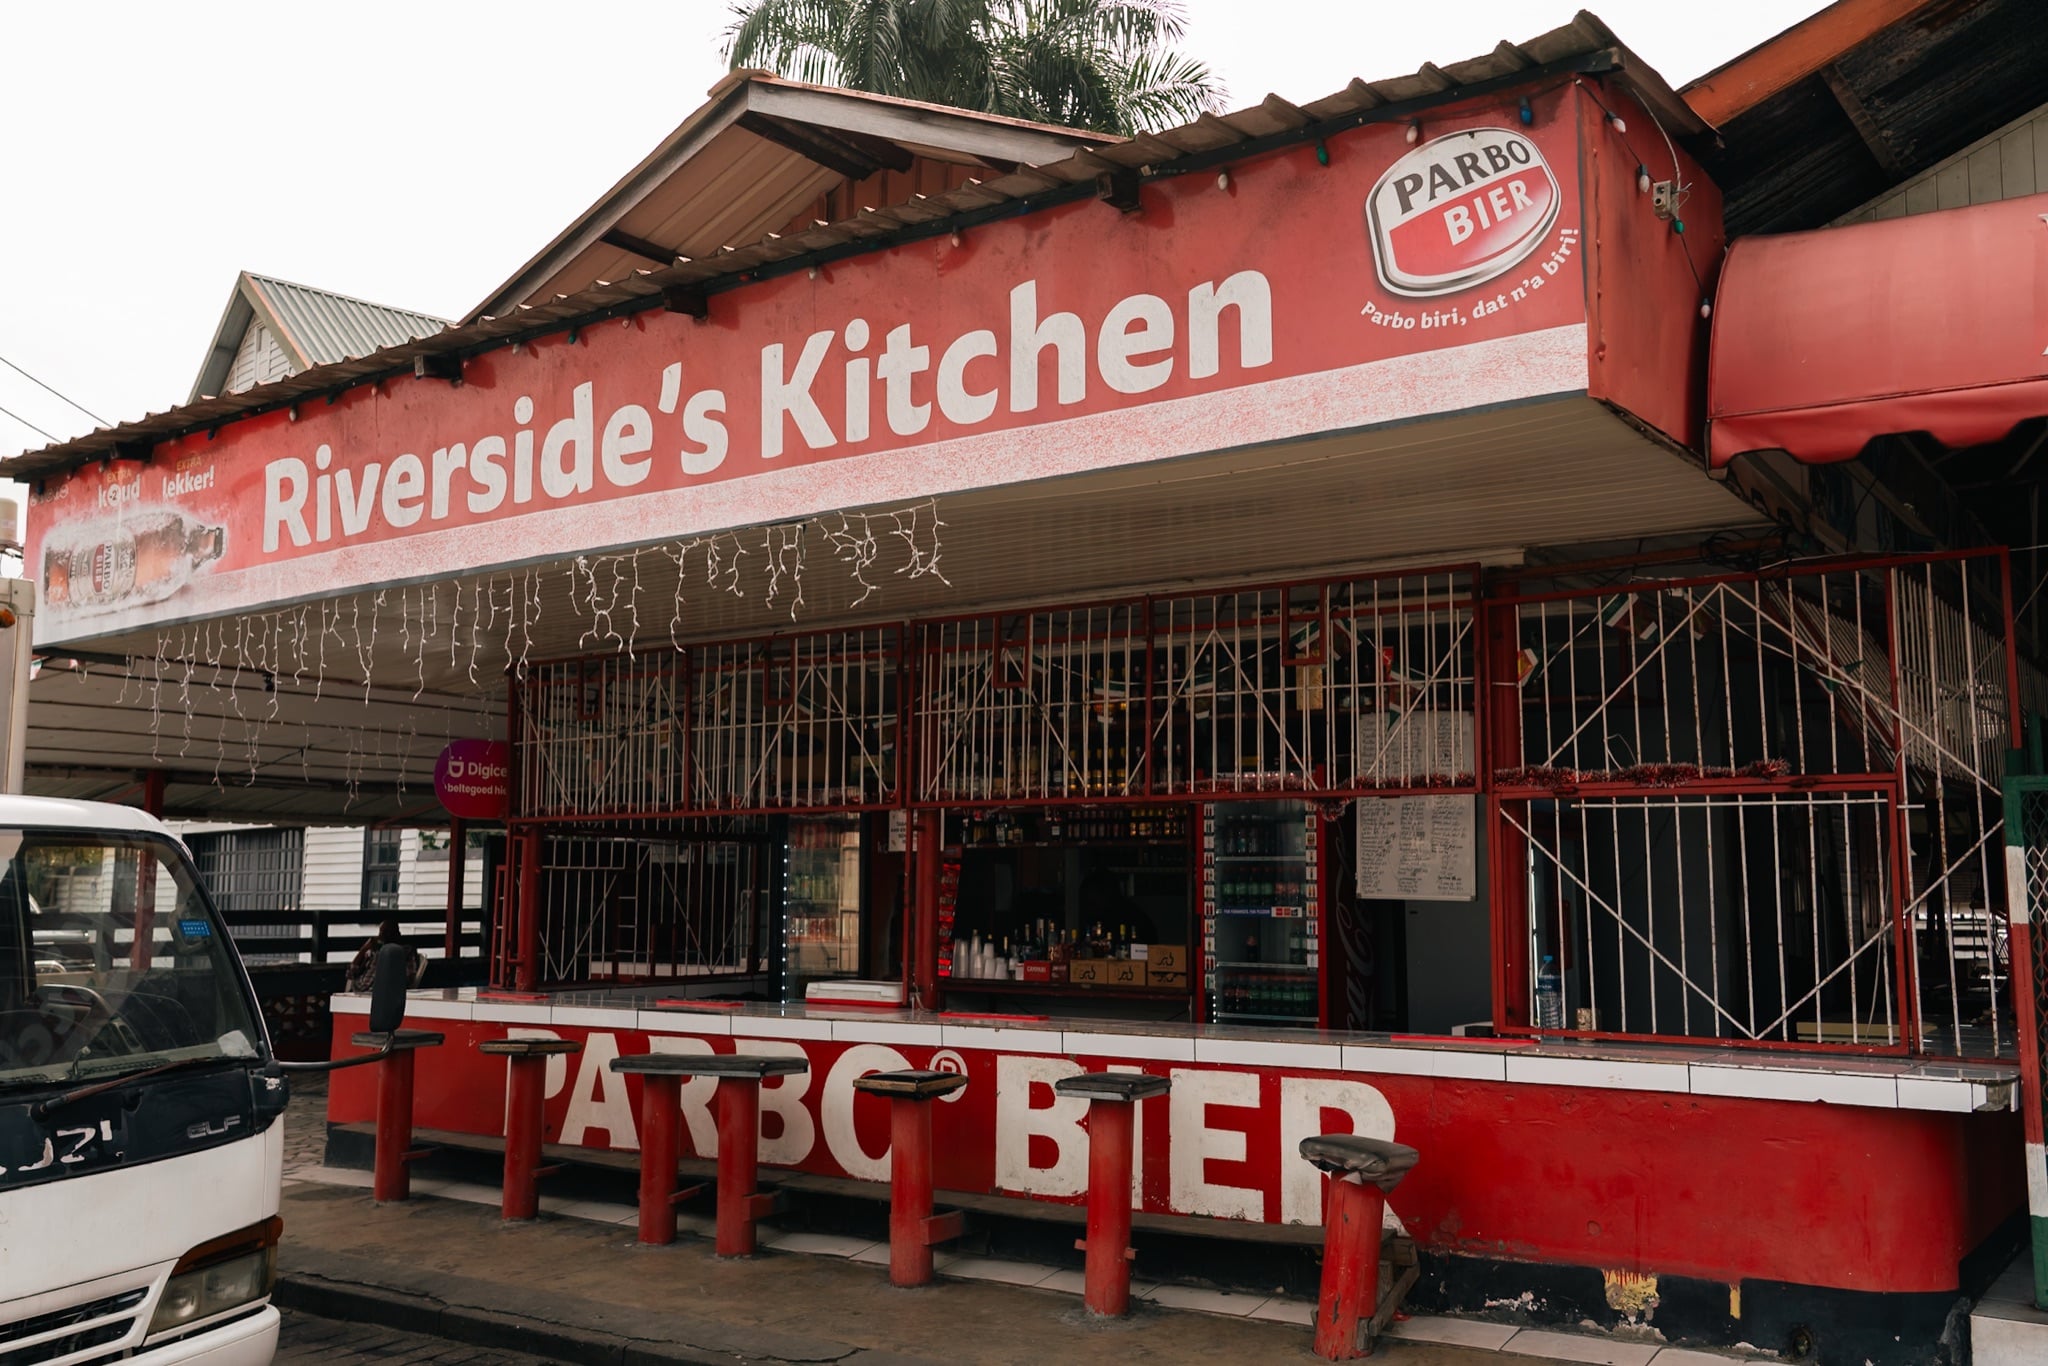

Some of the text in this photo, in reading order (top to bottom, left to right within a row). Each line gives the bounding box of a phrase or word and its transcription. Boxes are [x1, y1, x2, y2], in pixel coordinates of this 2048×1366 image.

[1392, 139, 1531, 215] PARBO
[1443, 179, 1534, 246] BIER
[1360, 301, 1416, 330] Parbo
[1420, 307, 1467, 330] biri,
[1472, 294, 1508, 320] dat
[1541, 228, 1579, 276] biri!
[263, 270, 1273, 554] Riverside's Kitchen
[162, 465, 215, 500] lekker!
[447, 783, 493, 796] beltegoed
[468, 762, 508, 779] Digice
[187, 1115, 241, 1139] ELF
[996, 1055, 1411, 1238] BER
